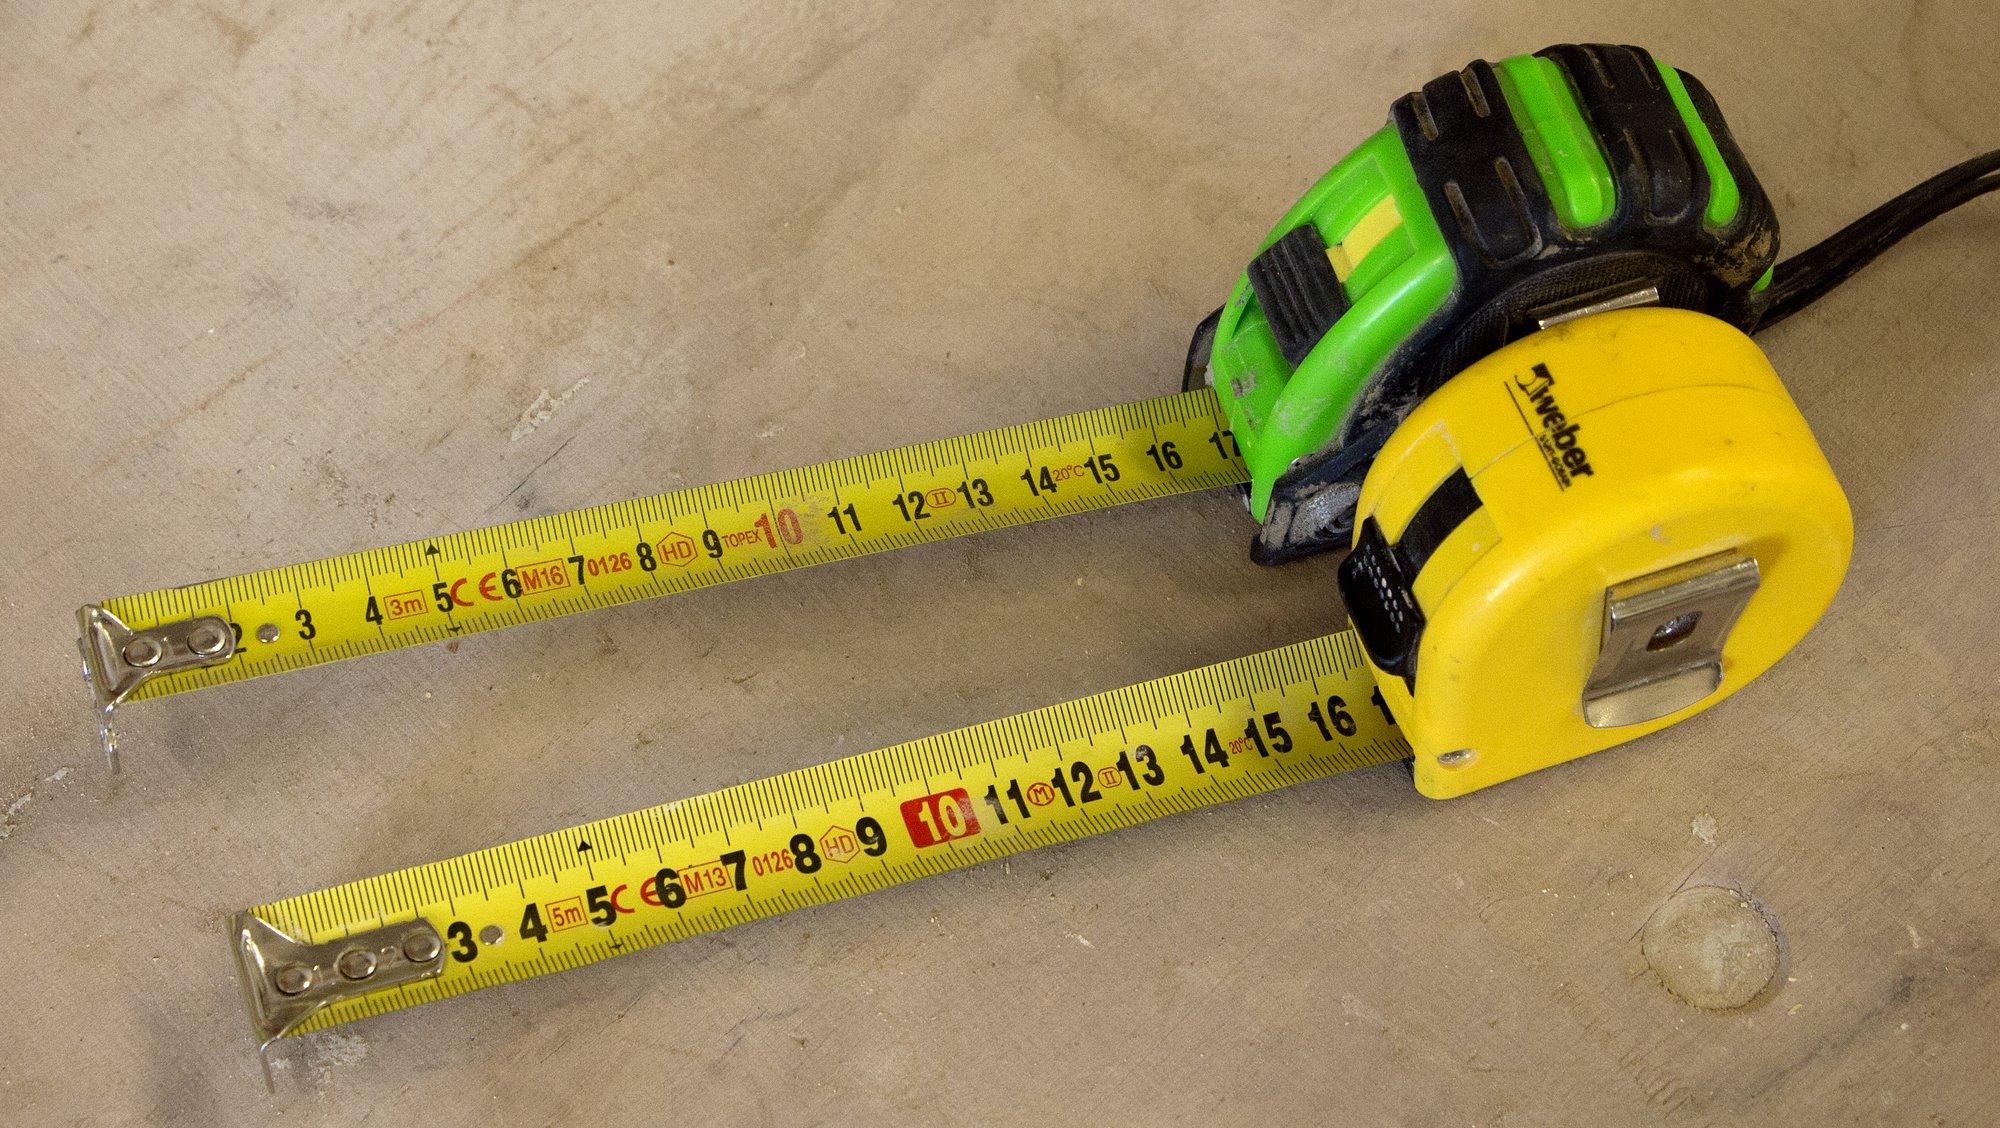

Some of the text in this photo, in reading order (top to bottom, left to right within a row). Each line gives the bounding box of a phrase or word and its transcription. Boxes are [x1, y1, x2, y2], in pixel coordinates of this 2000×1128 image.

[1530, 384, 1594, 478] weber
[295, 610, 316, 640] 3
[365, 596, 384, 626] 4
[390, 597, 423, 617] 3m
[434, 582, 454, 613] 5
[501, 569, 523, 599] 6
[524, 565, 564, 592] M16
[568, 555, 586, 585] 7
[587, 552, 632, 577] 0126
[636, 542, 657, 572] 8
[660, 541, 692, 562] HD
[702, 529, 723, 559] 9
[721, 530, 761, 547] TOPEX
[754, 508, 804, 549] 10
[827, 503, 862, 535] 11
[892, 491, 931, 522] 12
[956, 478, 995, 509] 13
[1020, 466, 1058, 497] 14
[1084, 454, 1121, 484] 15
[1146, 441, 1183, 472] 16
[447, 921, 478, 963] 3
[519, 903, 548, 943] 4
[551, 906, 582, 928] 5m
[585, 885, 617, 926] 5
[655, 868, 687, 909] 6
[683, 868, 726, 893] M13
[720, 850, 748, 891] 7
[752, 848, 793, 877] 0126
[789, 833, 822, 874] 8
[825, 835, 855, 857] HD
[855, 817, 887, 857] 9
[917, 795, 966, 842] 10
[983, 779, 1032, 825] 11
[1051, 761, 1103, 808] 12
[1116, 744, 1165, 790] 13
[1180, 729, 1229, 774] 14
[1245, 712, 1293, 758] 15
[1307, 695, 1357, 741] 16
[1371, 685, 1397, 725] 1
